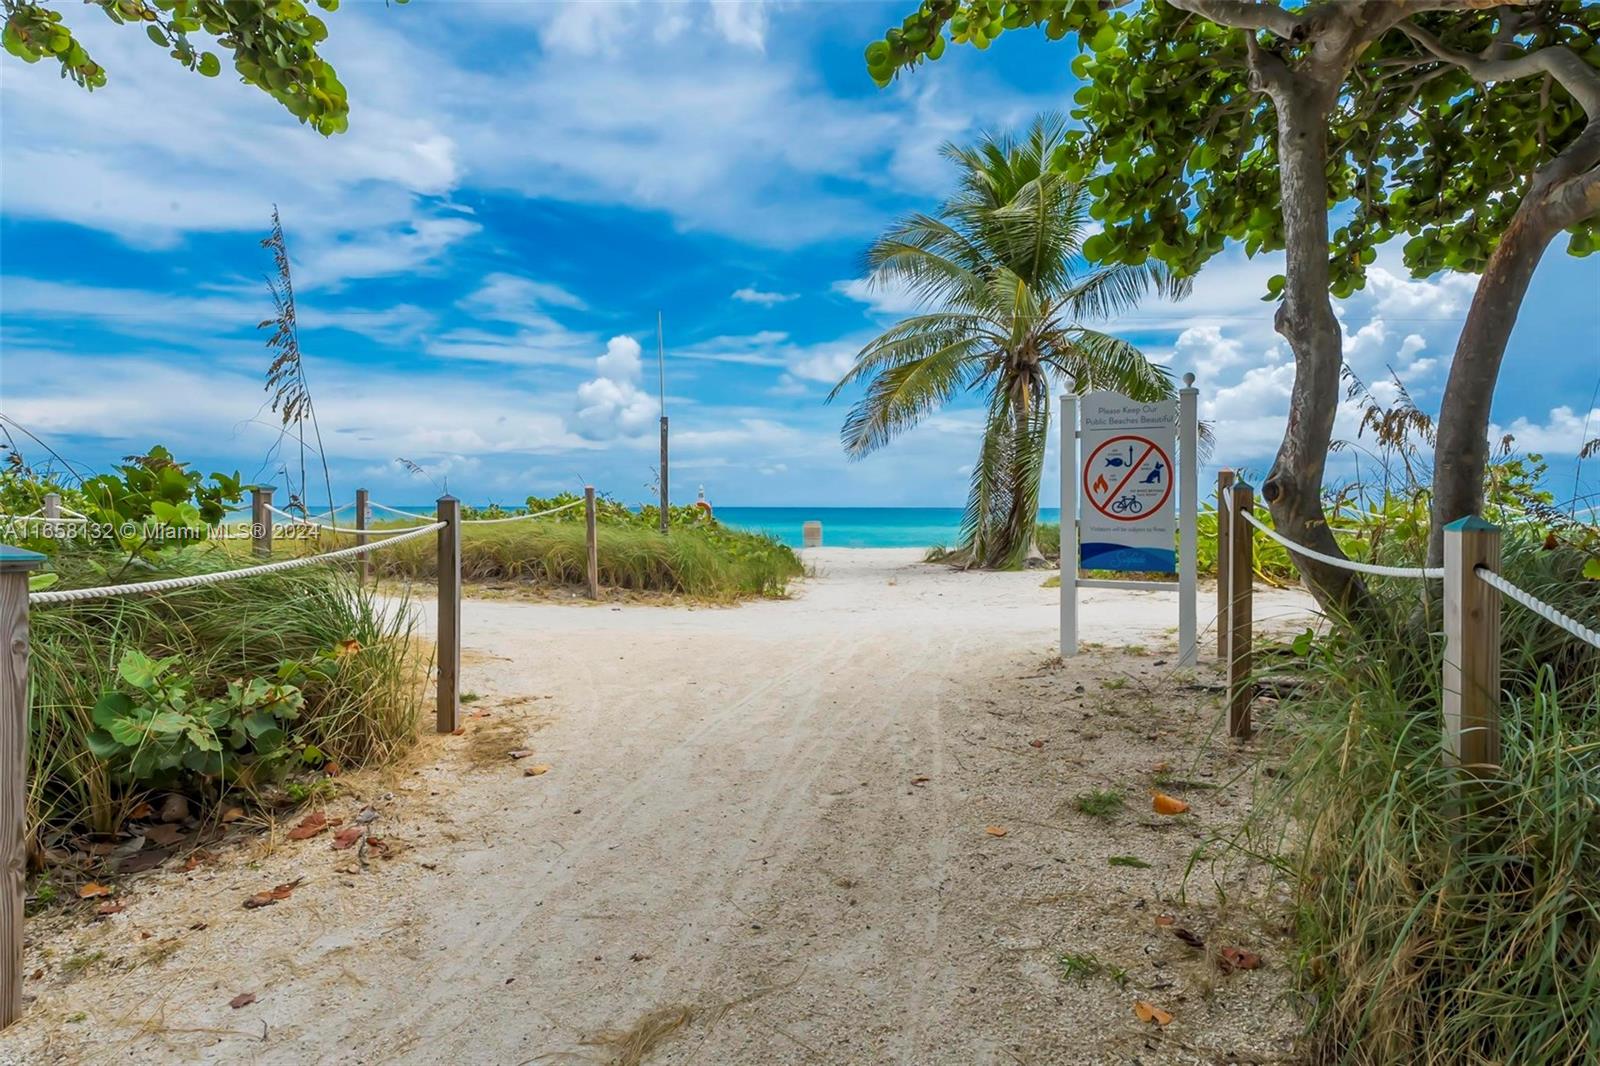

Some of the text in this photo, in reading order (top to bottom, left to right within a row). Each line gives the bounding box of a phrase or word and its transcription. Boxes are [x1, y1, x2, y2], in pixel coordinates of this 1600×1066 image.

[1123, 406, 1141, 415] Keep
[1142, 405, 1157, 413] Our
[1086, 414, 1174, 425] Public Beaches Beautiful
